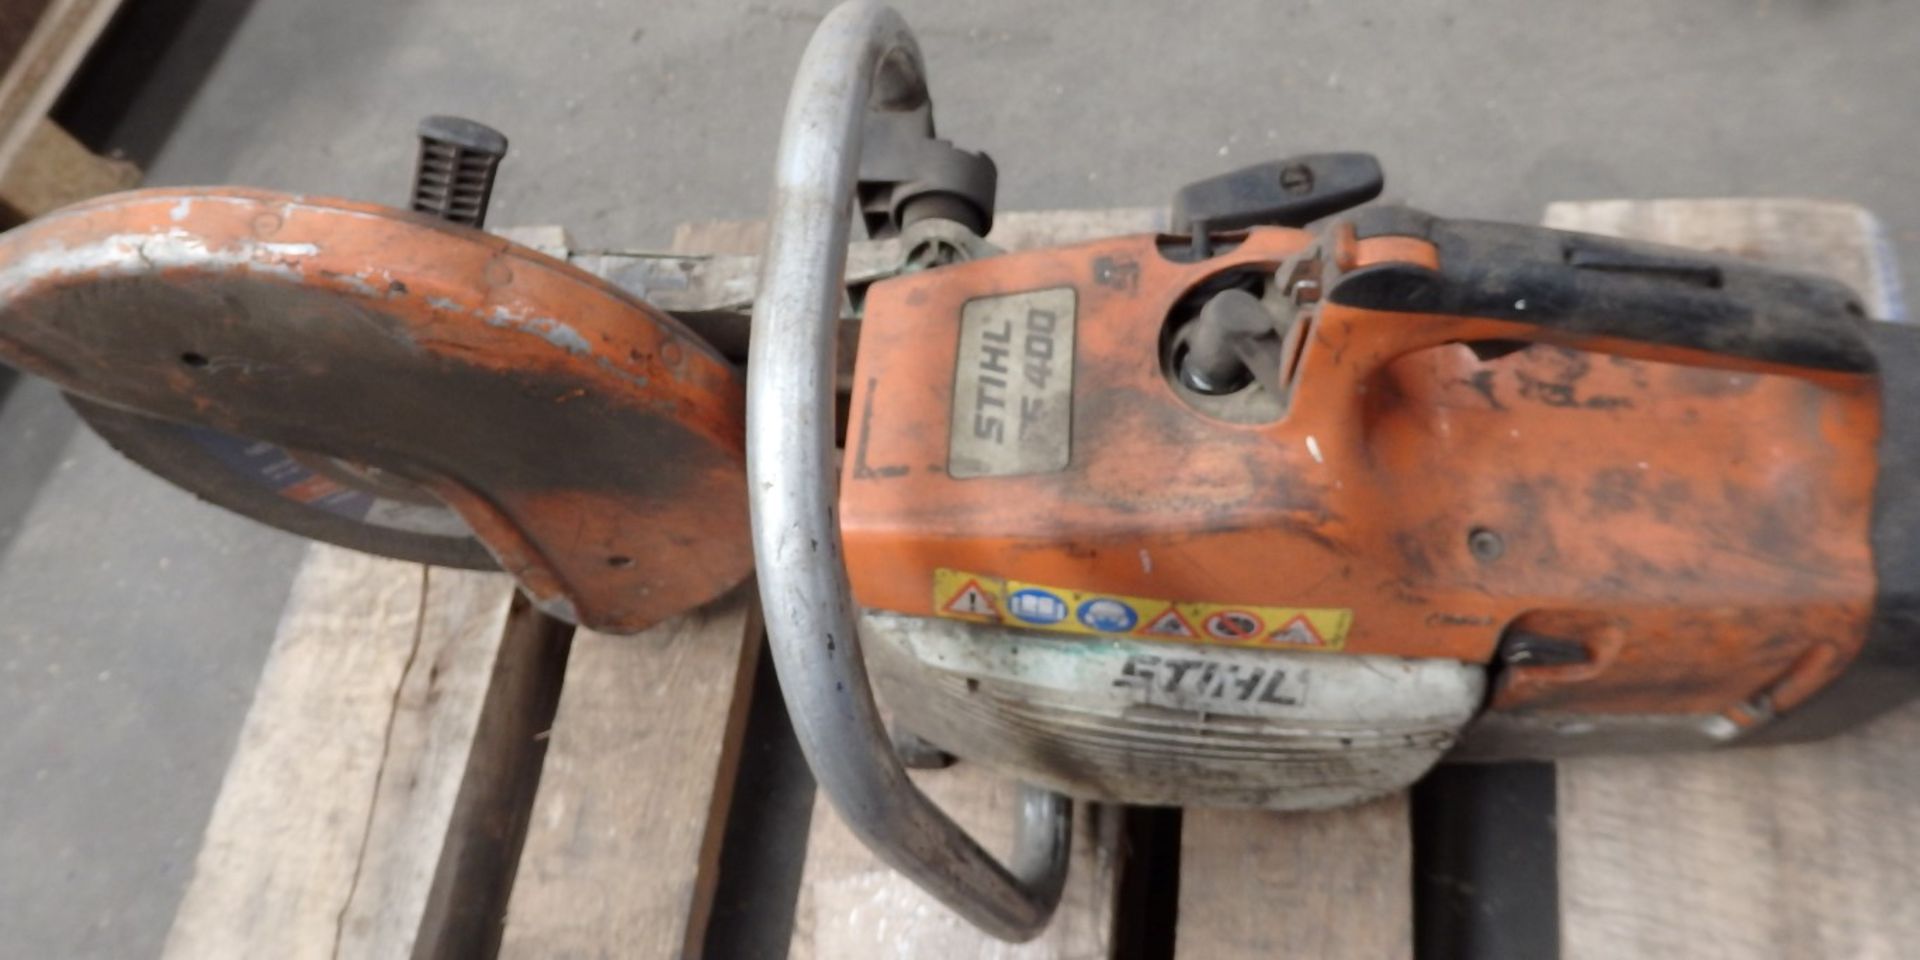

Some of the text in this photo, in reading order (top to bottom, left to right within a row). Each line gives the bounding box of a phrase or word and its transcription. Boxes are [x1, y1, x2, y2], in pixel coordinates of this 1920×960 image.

[973, 319, 1012, 445] STIHL
[1023, 308, 1057, 390] 400
[1112, 655, 1299, 707] STIHL
